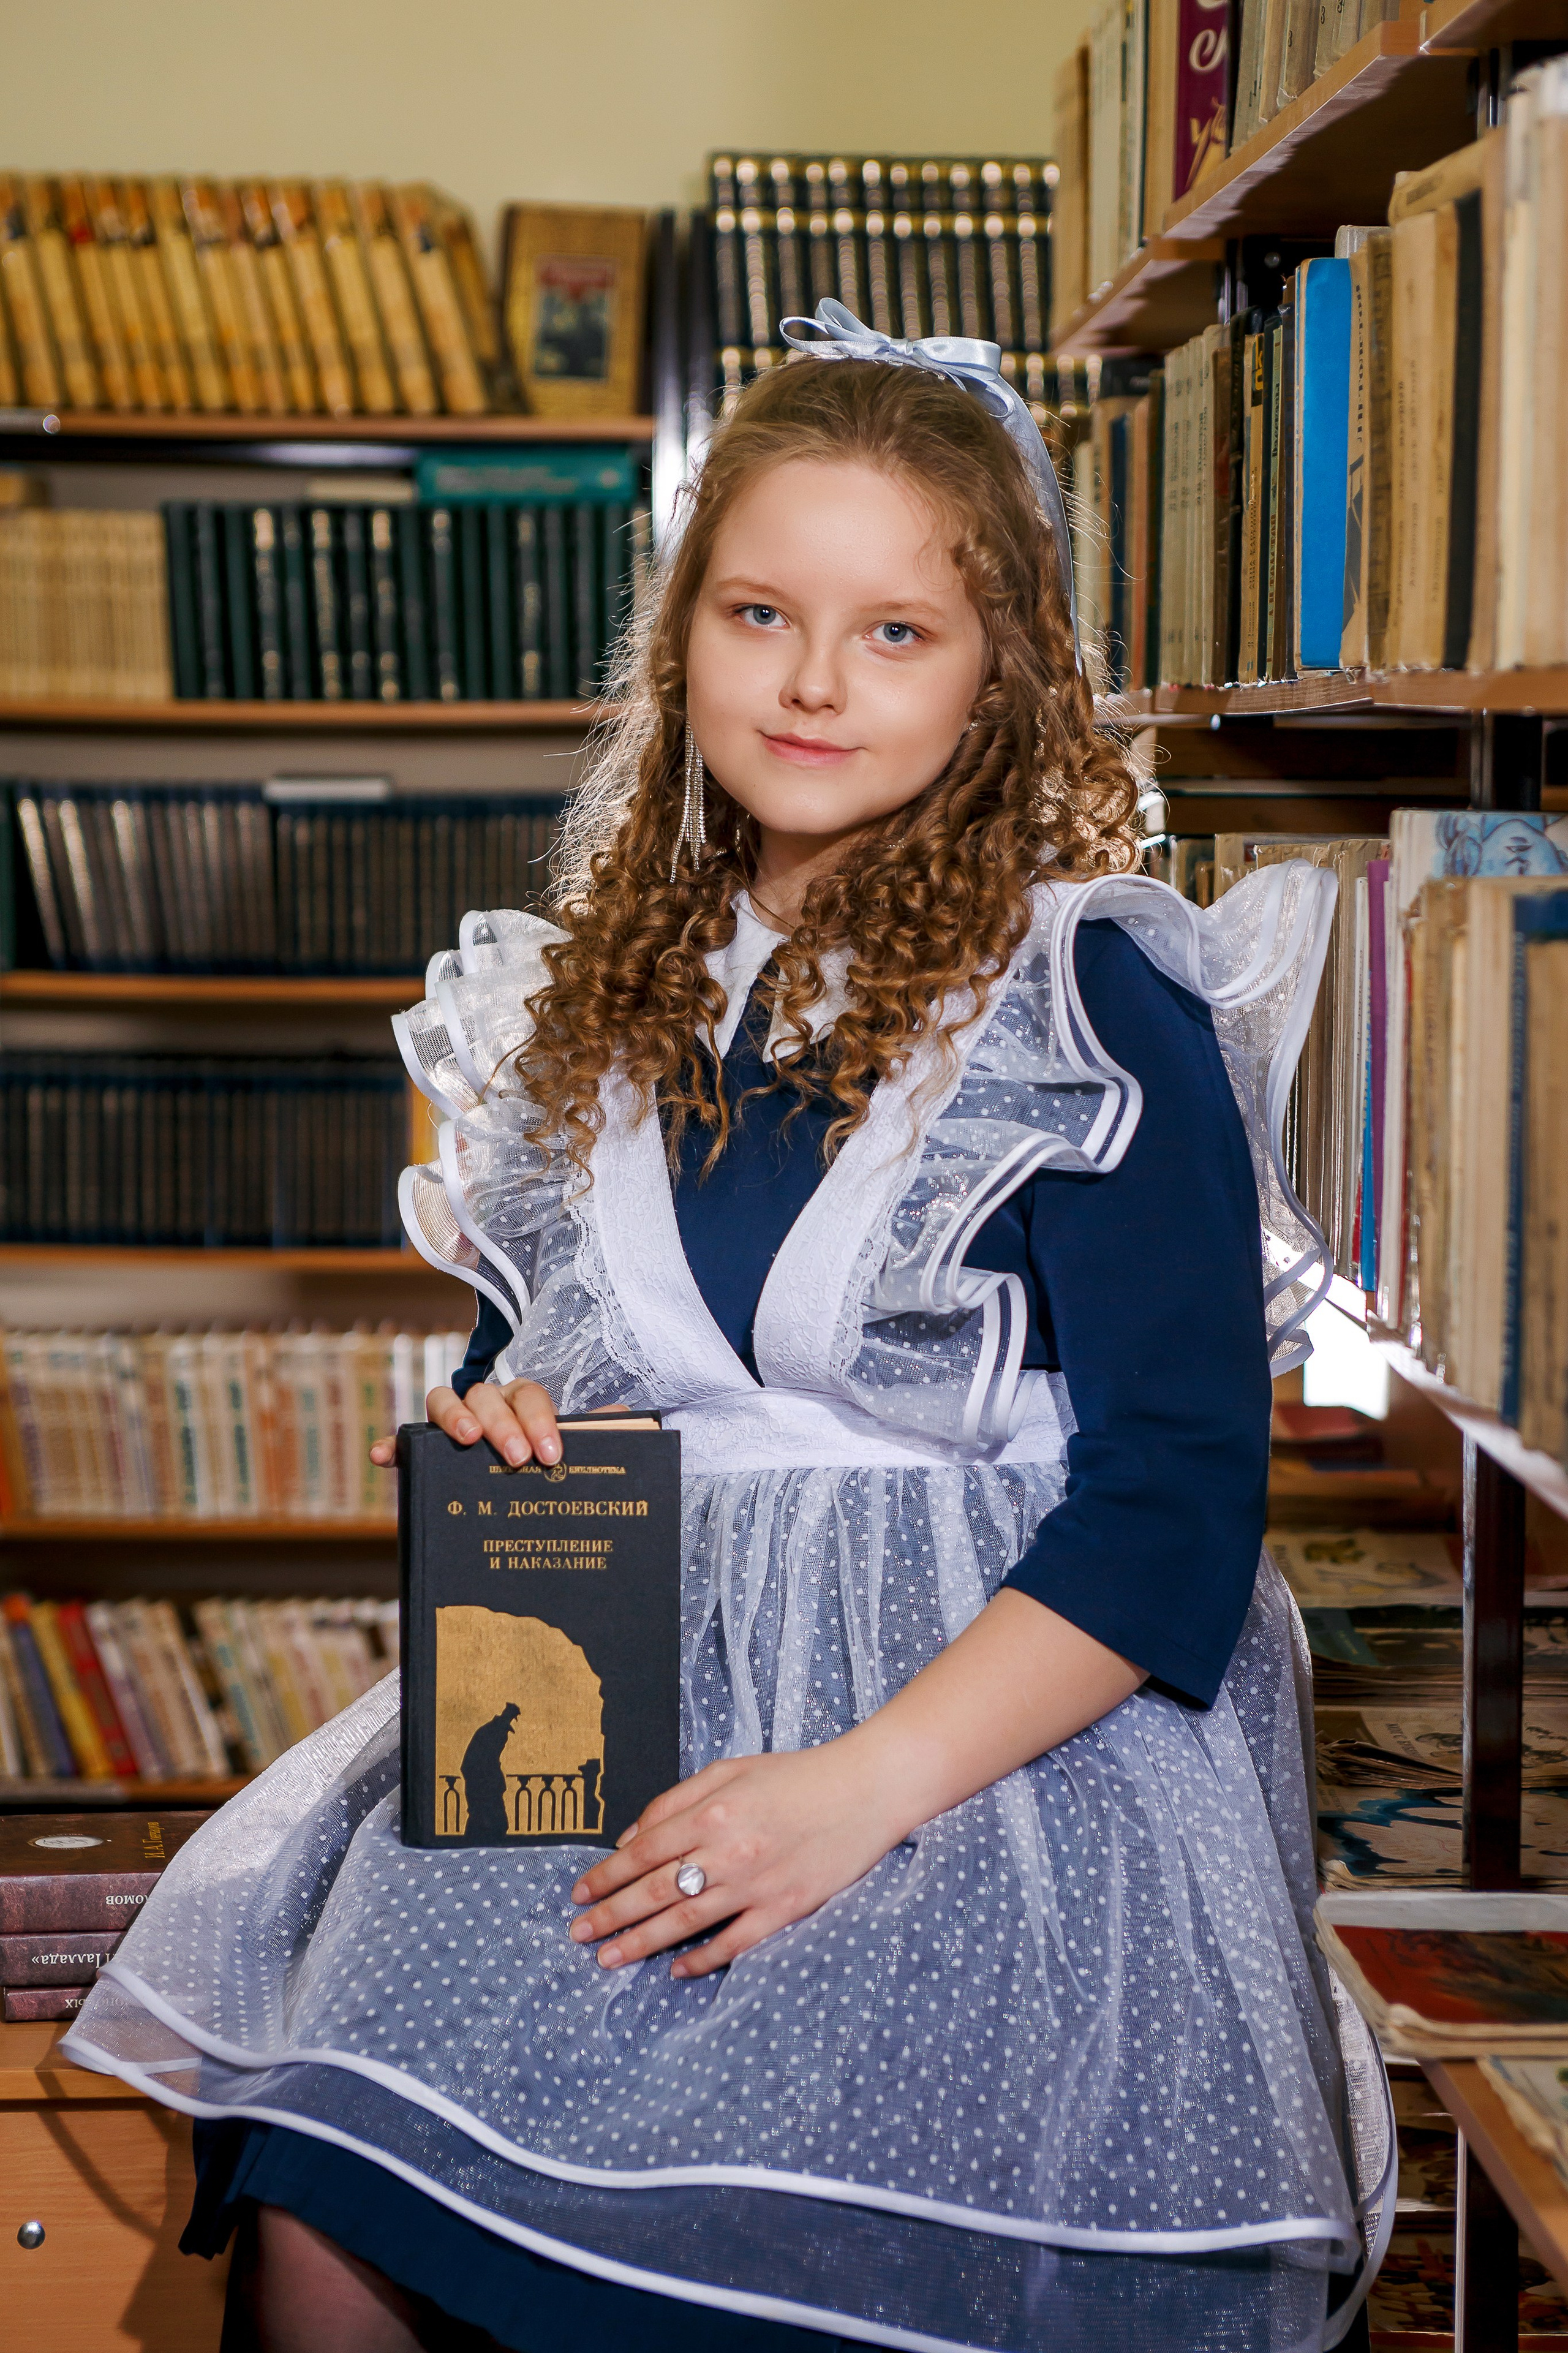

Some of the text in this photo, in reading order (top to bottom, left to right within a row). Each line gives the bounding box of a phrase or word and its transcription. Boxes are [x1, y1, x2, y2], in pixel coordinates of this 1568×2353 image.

[568, 1466, 626, 1475] БИБЛИОТЕКА
[447, 1500, 649, 1517] Ф. М. ДОСТОЕВСКИЙ
[483, 1539, 614, 1553] ПРЕСТУПЛЕНИЕ
[489, 1557, 608, 1570] И НАКАЗАНИЕ
[105, 1895, 148, 1905] омов
